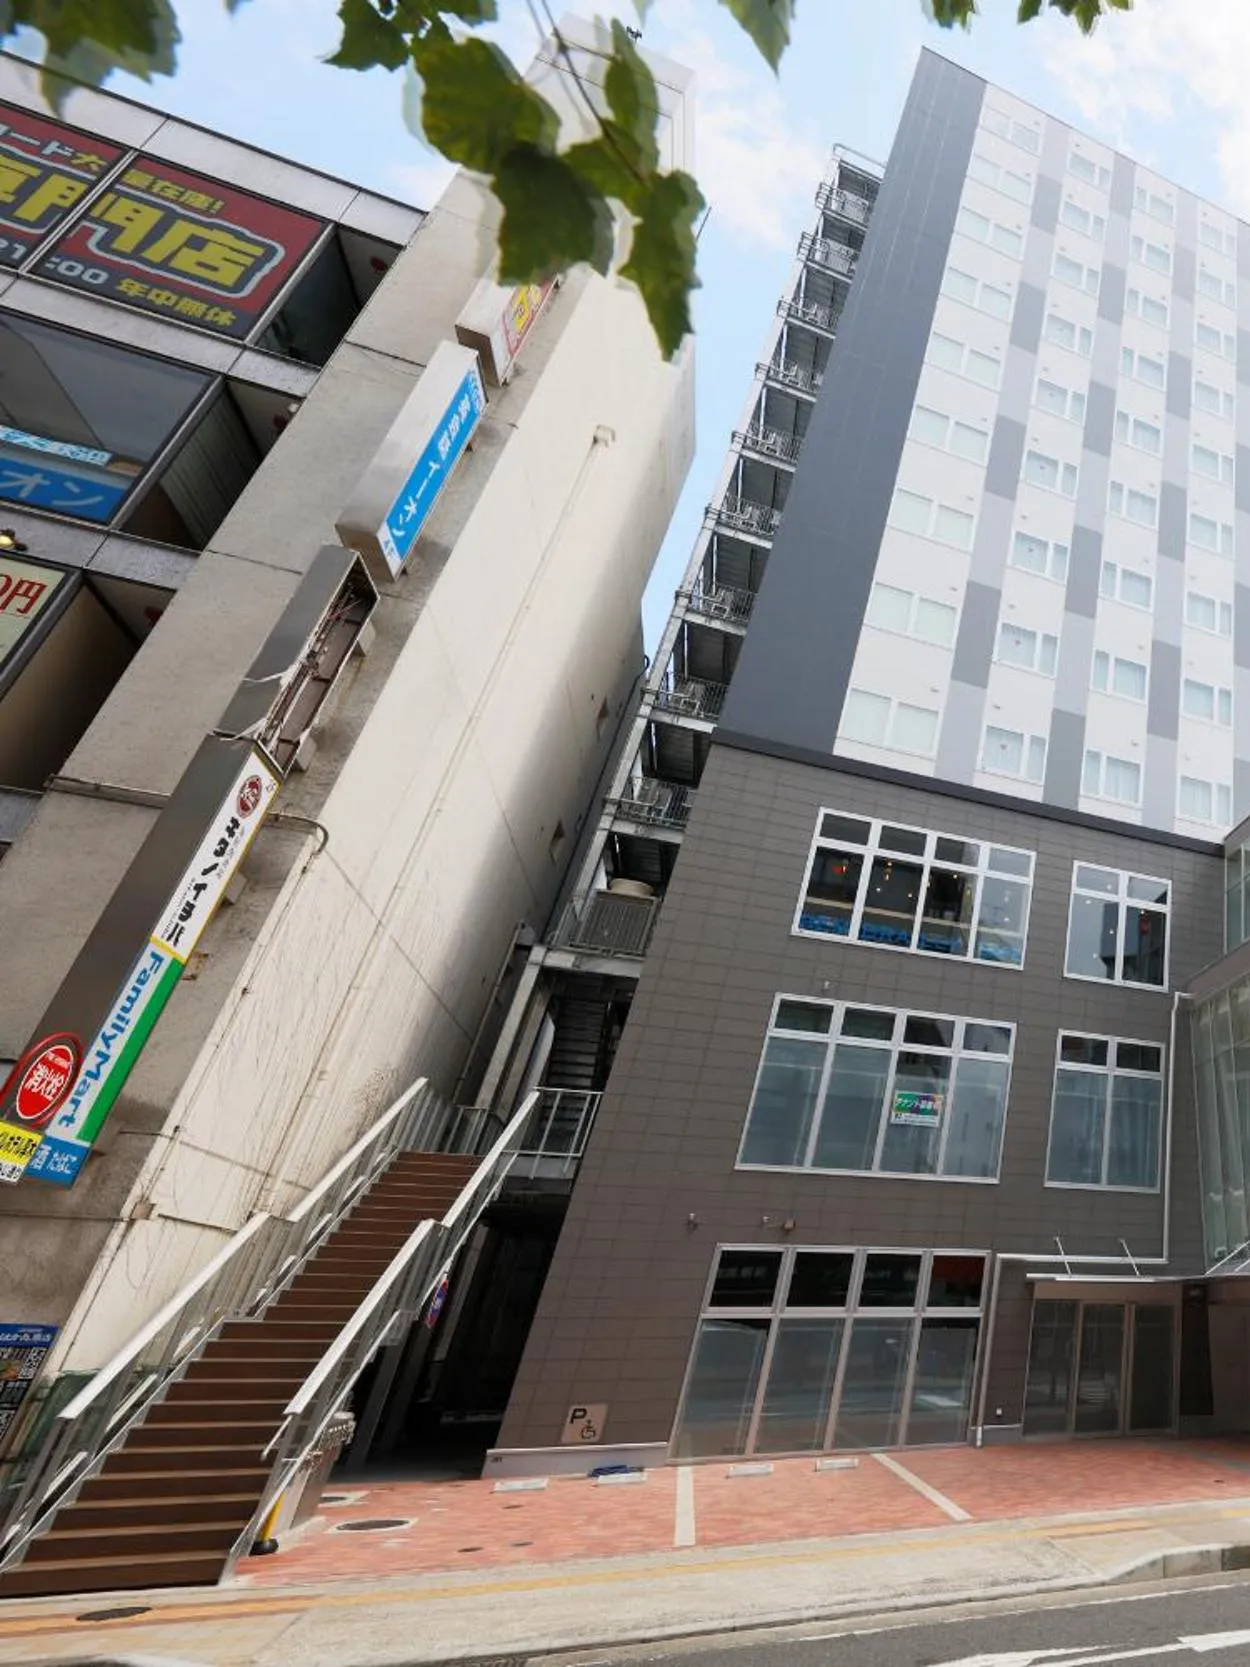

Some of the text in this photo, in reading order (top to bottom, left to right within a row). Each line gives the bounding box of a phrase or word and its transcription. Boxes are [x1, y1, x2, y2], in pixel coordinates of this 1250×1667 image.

[116, 276, 237, 327] 年中無休
[58, 951, 165, 1128] FamilyMart
[570, 1407, 587, 1424] P
